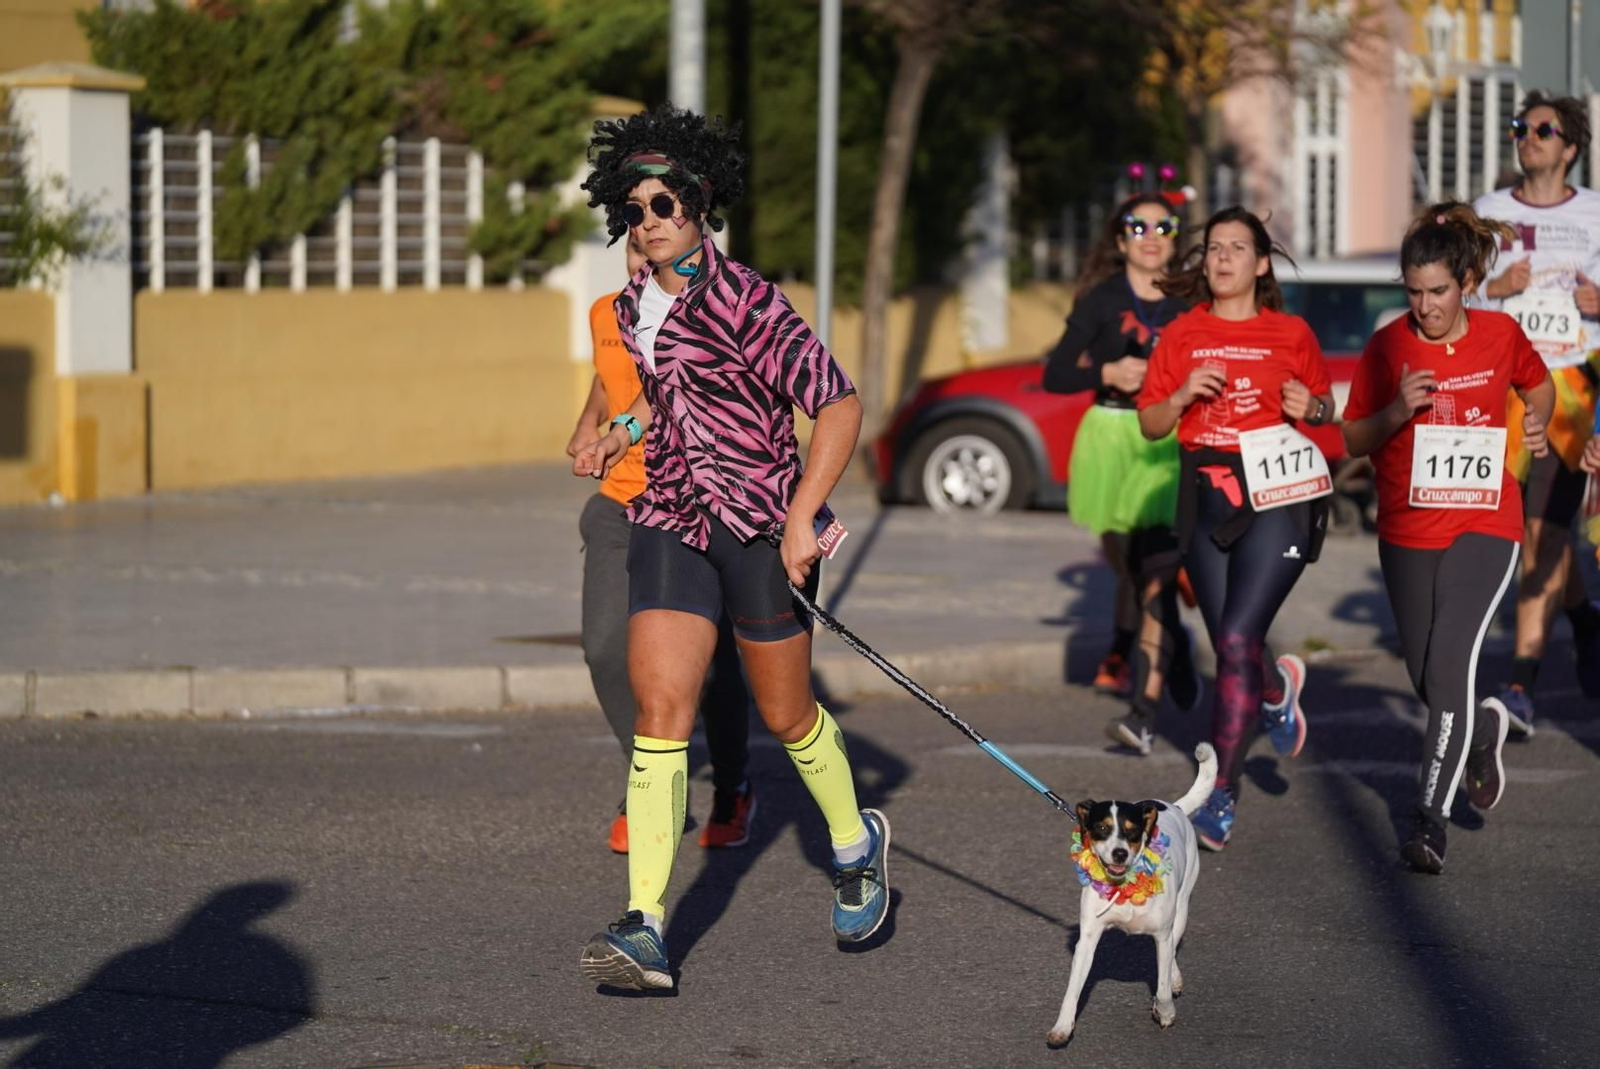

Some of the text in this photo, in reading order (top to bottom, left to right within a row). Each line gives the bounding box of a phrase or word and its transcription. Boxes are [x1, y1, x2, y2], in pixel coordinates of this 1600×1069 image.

[1516, 312, 1570, 334] 1073
[1235, 377, 1251, 390] 50
[1465, 406, 1480, 422] 50
[1258, 446, 1313, 479] 1177
[1426, 455, 1491, 479] 1176
[1258, 481, 1319, 503] Cruzcampo
[1418, 488, 1482, 503] Cruzcampo
[1435, 710, 1454, 759] MOUSE
